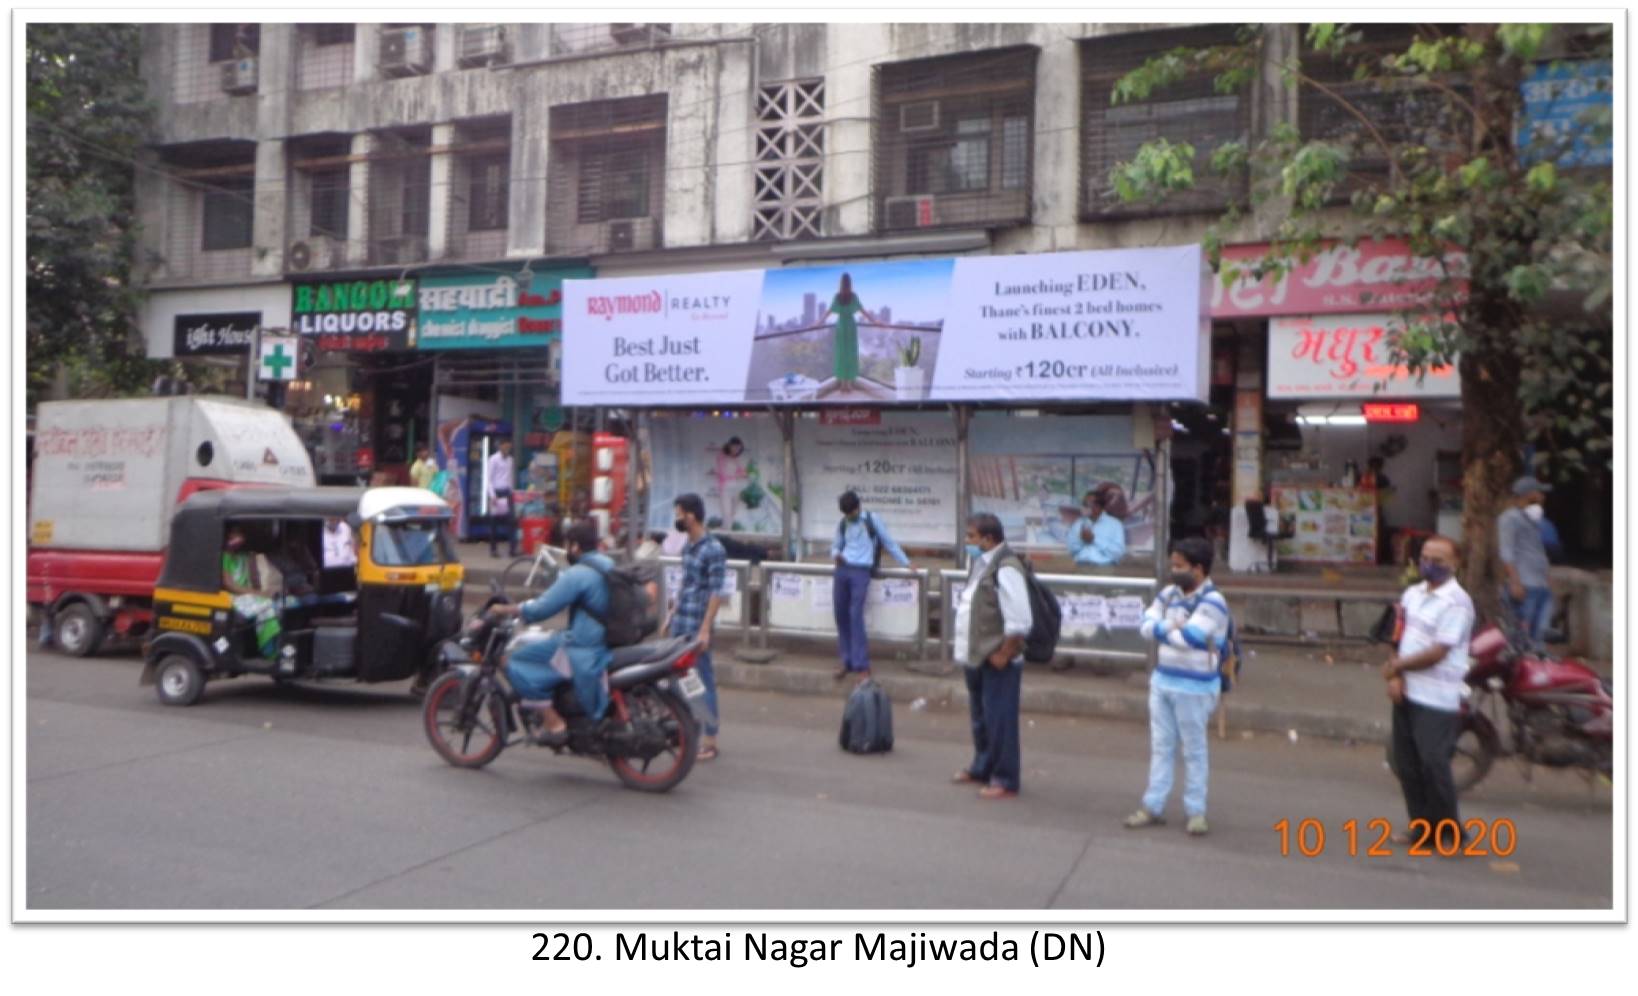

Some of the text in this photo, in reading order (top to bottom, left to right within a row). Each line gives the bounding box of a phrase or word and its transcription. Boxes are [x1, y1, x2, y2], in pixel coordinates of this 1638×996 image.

[994, 271, 1147, 297] Launching EDEN,
[587, 290, 662, 320] Raymond
[671, 295, 731, 310] REALTY
[980, 299, 1163, 318] Thane's finest 2 bed homes
[301, 309, 407, 334] LIQUORS
[998, 319, 1141, 341] with BALCONY.
[613, 334, 701, 357] Best Just
[604, 361, 710, 383] Got Better.
[964, 367, 1013, 381] Starting
[1116, 364, 1179, 377] Inclusive)
